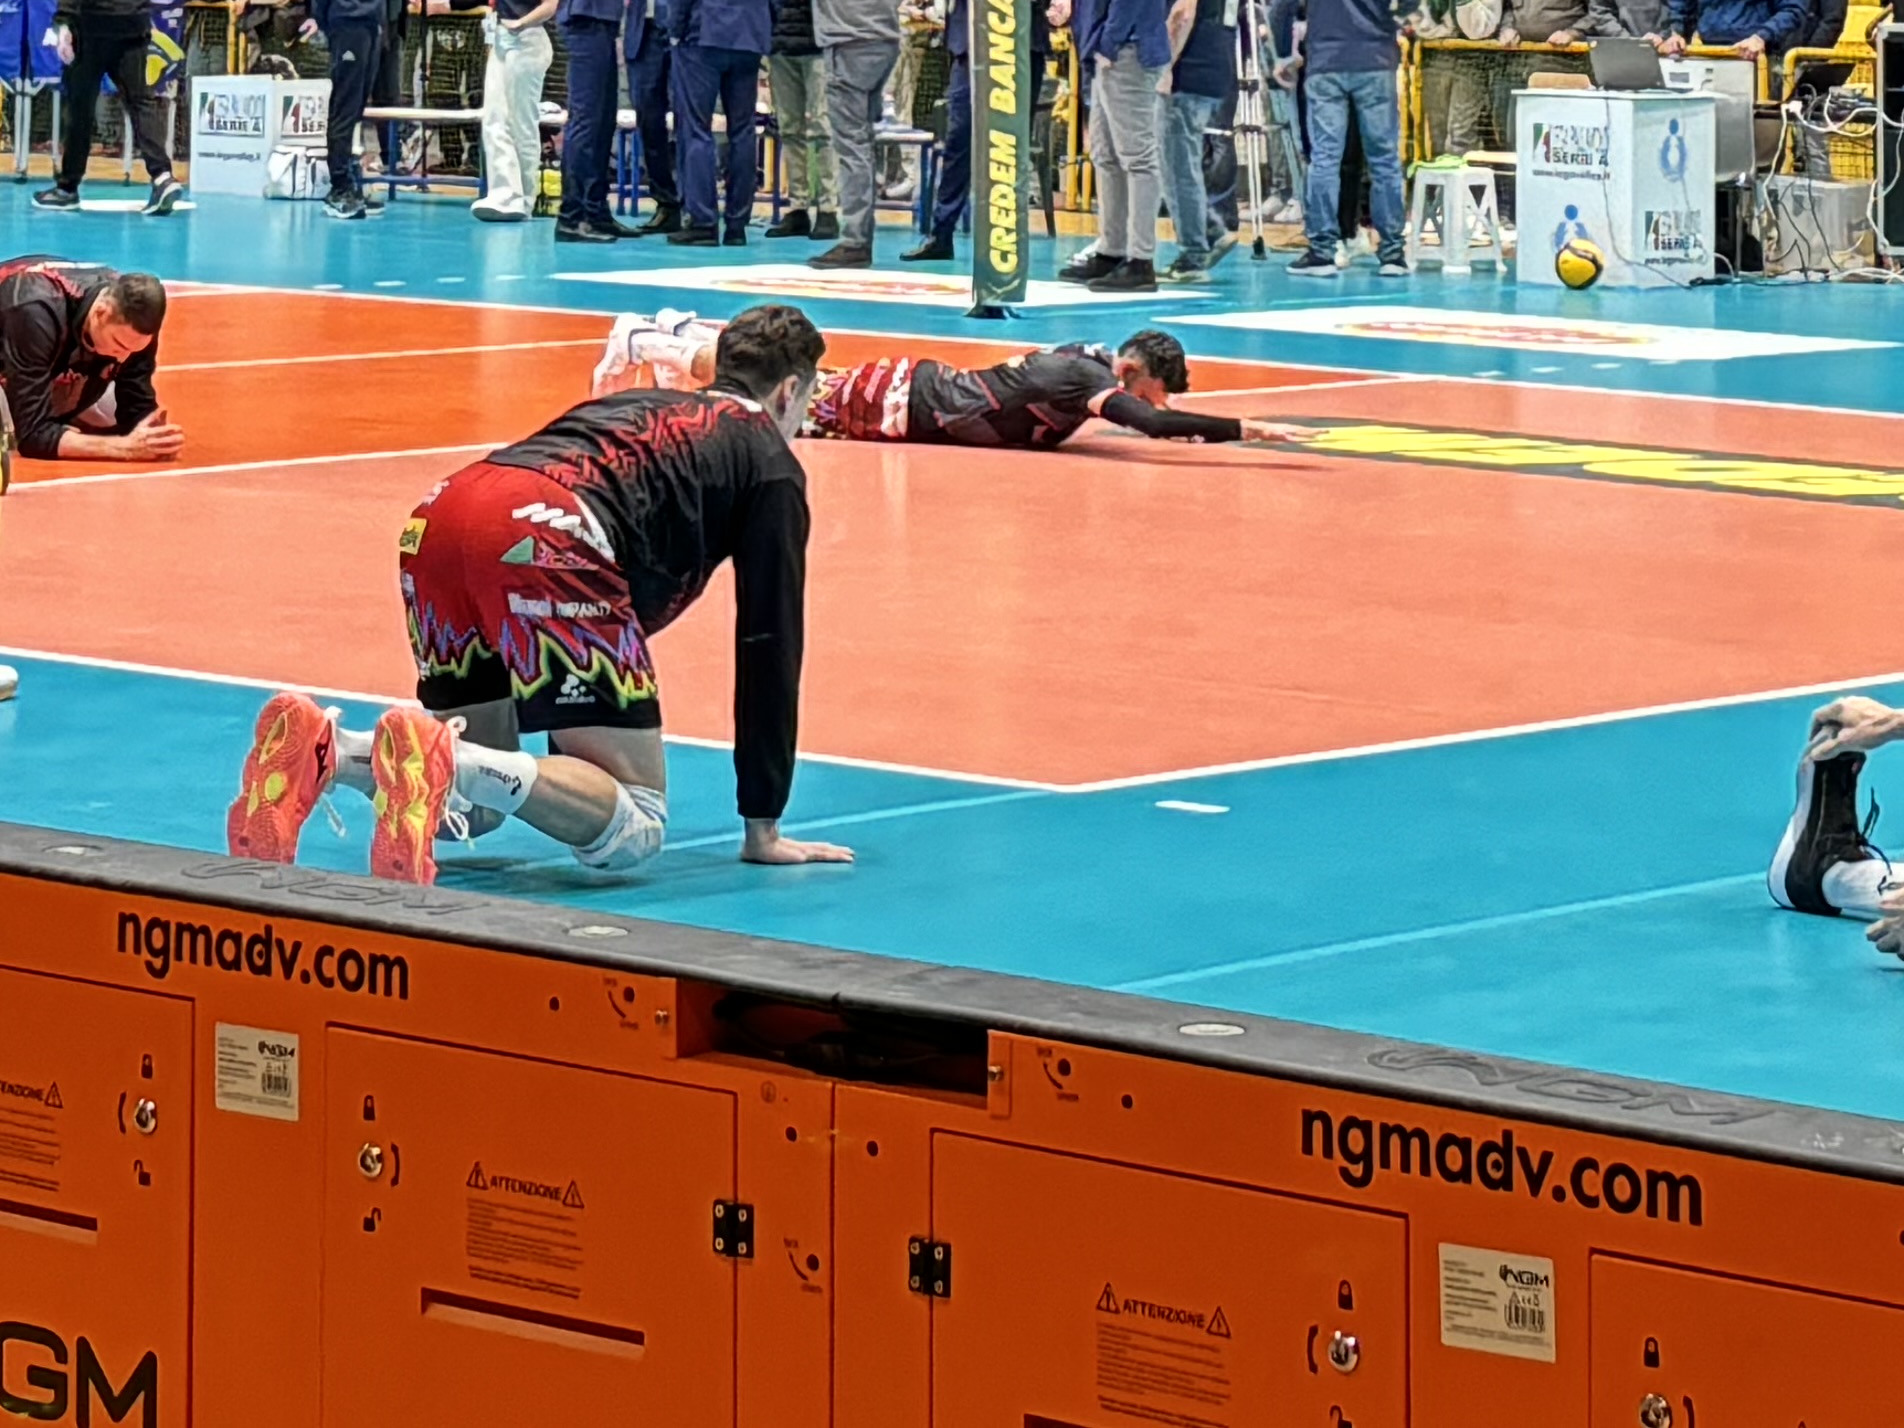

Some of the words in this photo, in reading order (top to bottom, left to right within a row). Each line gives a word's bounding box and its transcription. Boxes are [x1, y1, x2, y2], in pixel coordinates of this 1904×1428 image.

[987, 138, 1017, 275] CREDEM
[117, 910, 410, 1000] ngmadv.com
[1301, 1108, 1704, 1227] ngmadv.com
[1123, 1298, 1206, 1330] ATTENZIONE
